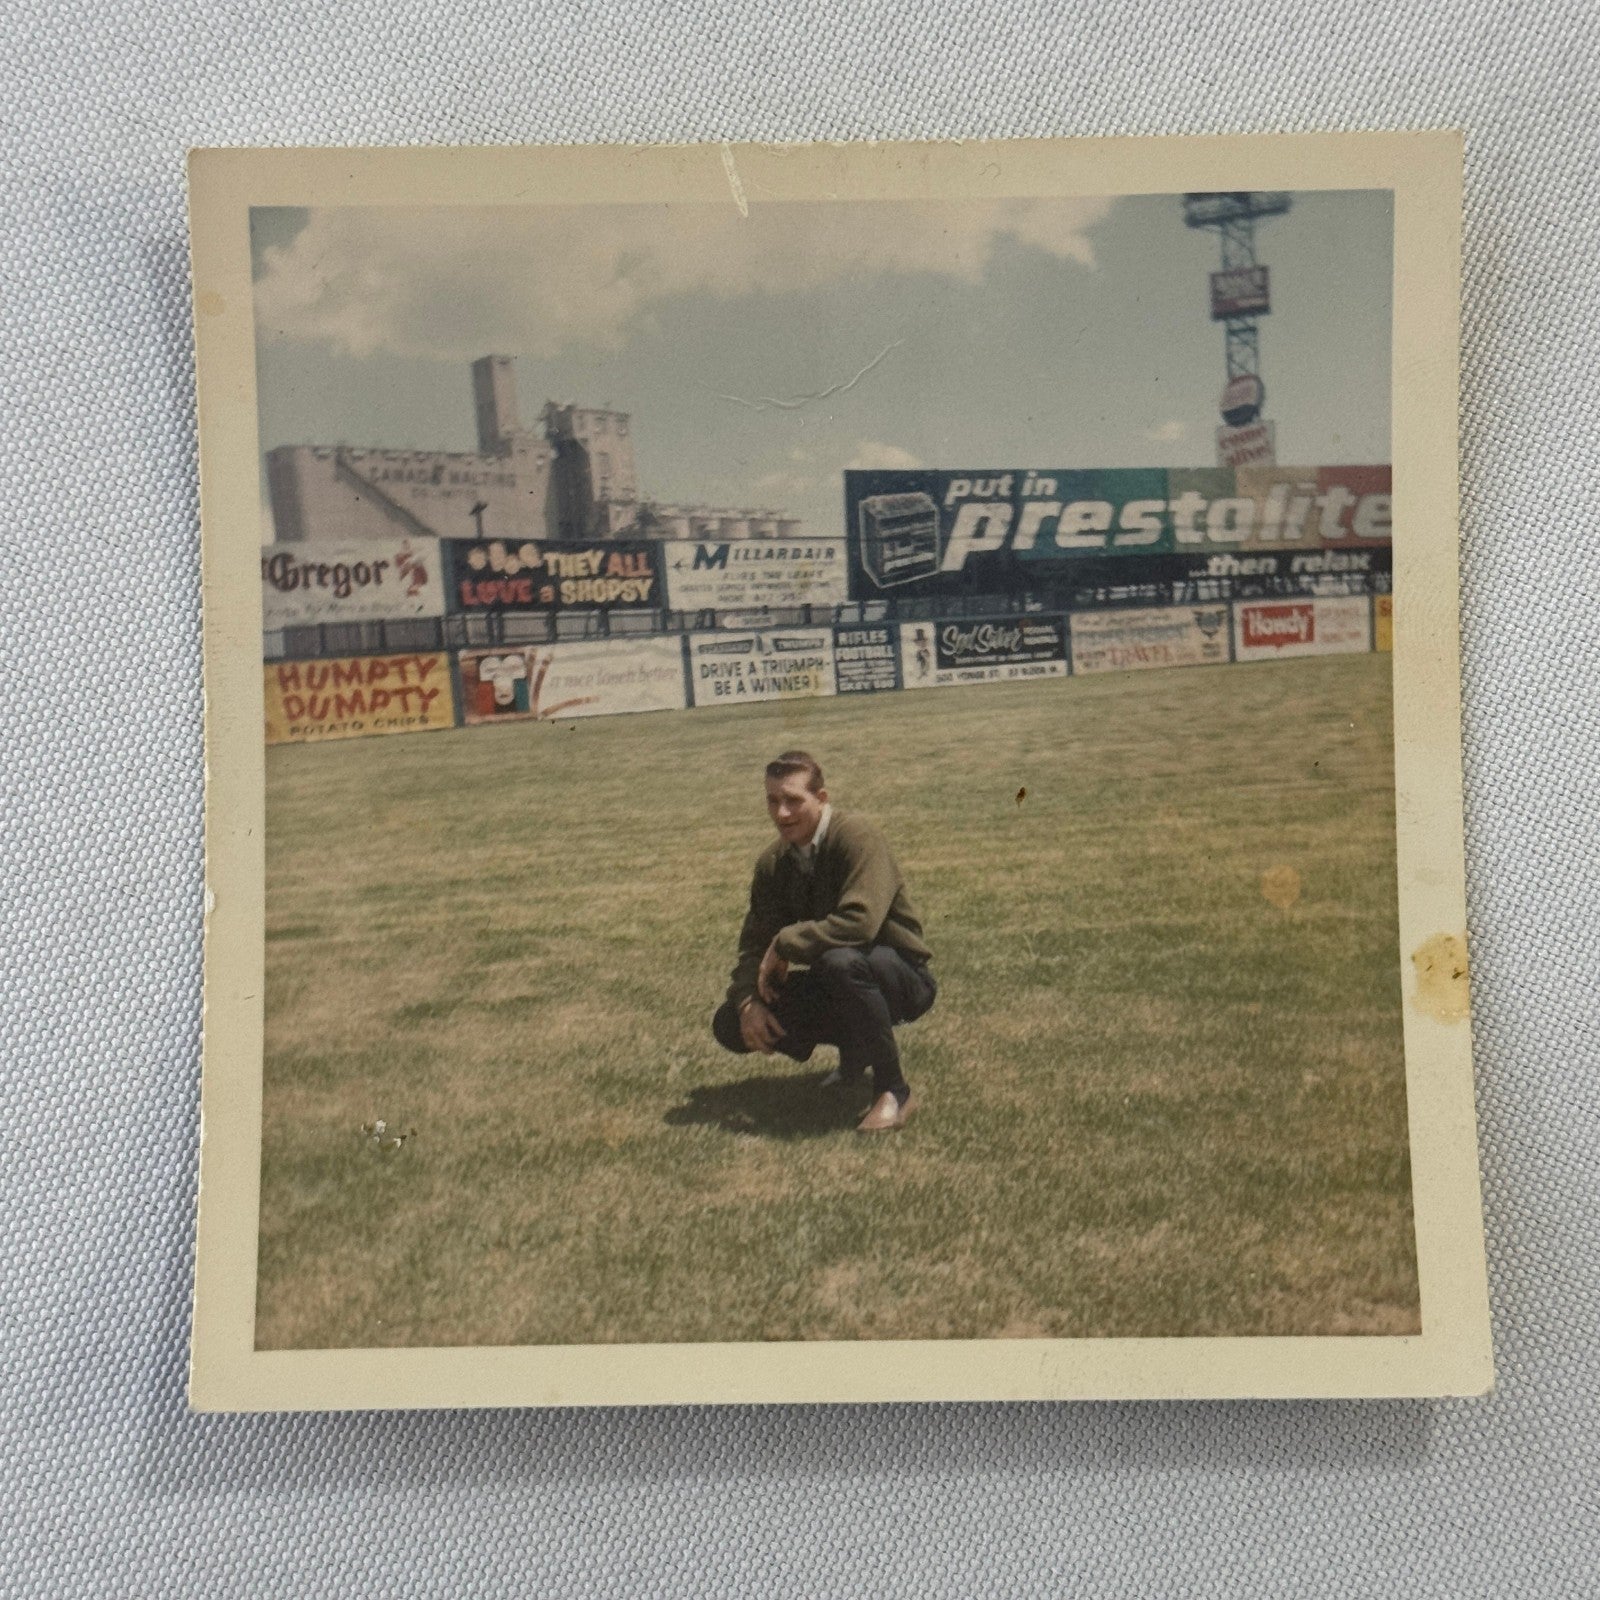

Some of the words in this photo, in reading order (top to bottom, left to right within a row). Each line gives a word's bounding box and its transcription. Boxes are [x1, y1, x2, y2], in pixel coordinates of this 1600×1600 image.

[945, 473, 1015, 507] put
[1021, 470, 1058, 496] in
[940, 482, 1392, 572] prestolite
[543, 548, 605, 577] THEY
[605, 551, 654, 577] ALL
[1291, 552, 1370, 573] relax
[459, 578, 534, 606] LOVE
[560, 577, 654, 605] SHOPSY
[838, 629, 888, 646] RIFLES
[835, 645, 895, 660] FOOTBALL
[277, 655, 439, 692] HUMPTY
[701, 661, 742, 679] DRIVE
[747, 661, 757, 675] A
[713, 680, 732, 696] BE
[736, 679, 747, 695] A
[282, 685, 440, 722] DUMPTY
[289, 720, 364, 737] POTATO
[373, 714, 430, 729] CHIPS
